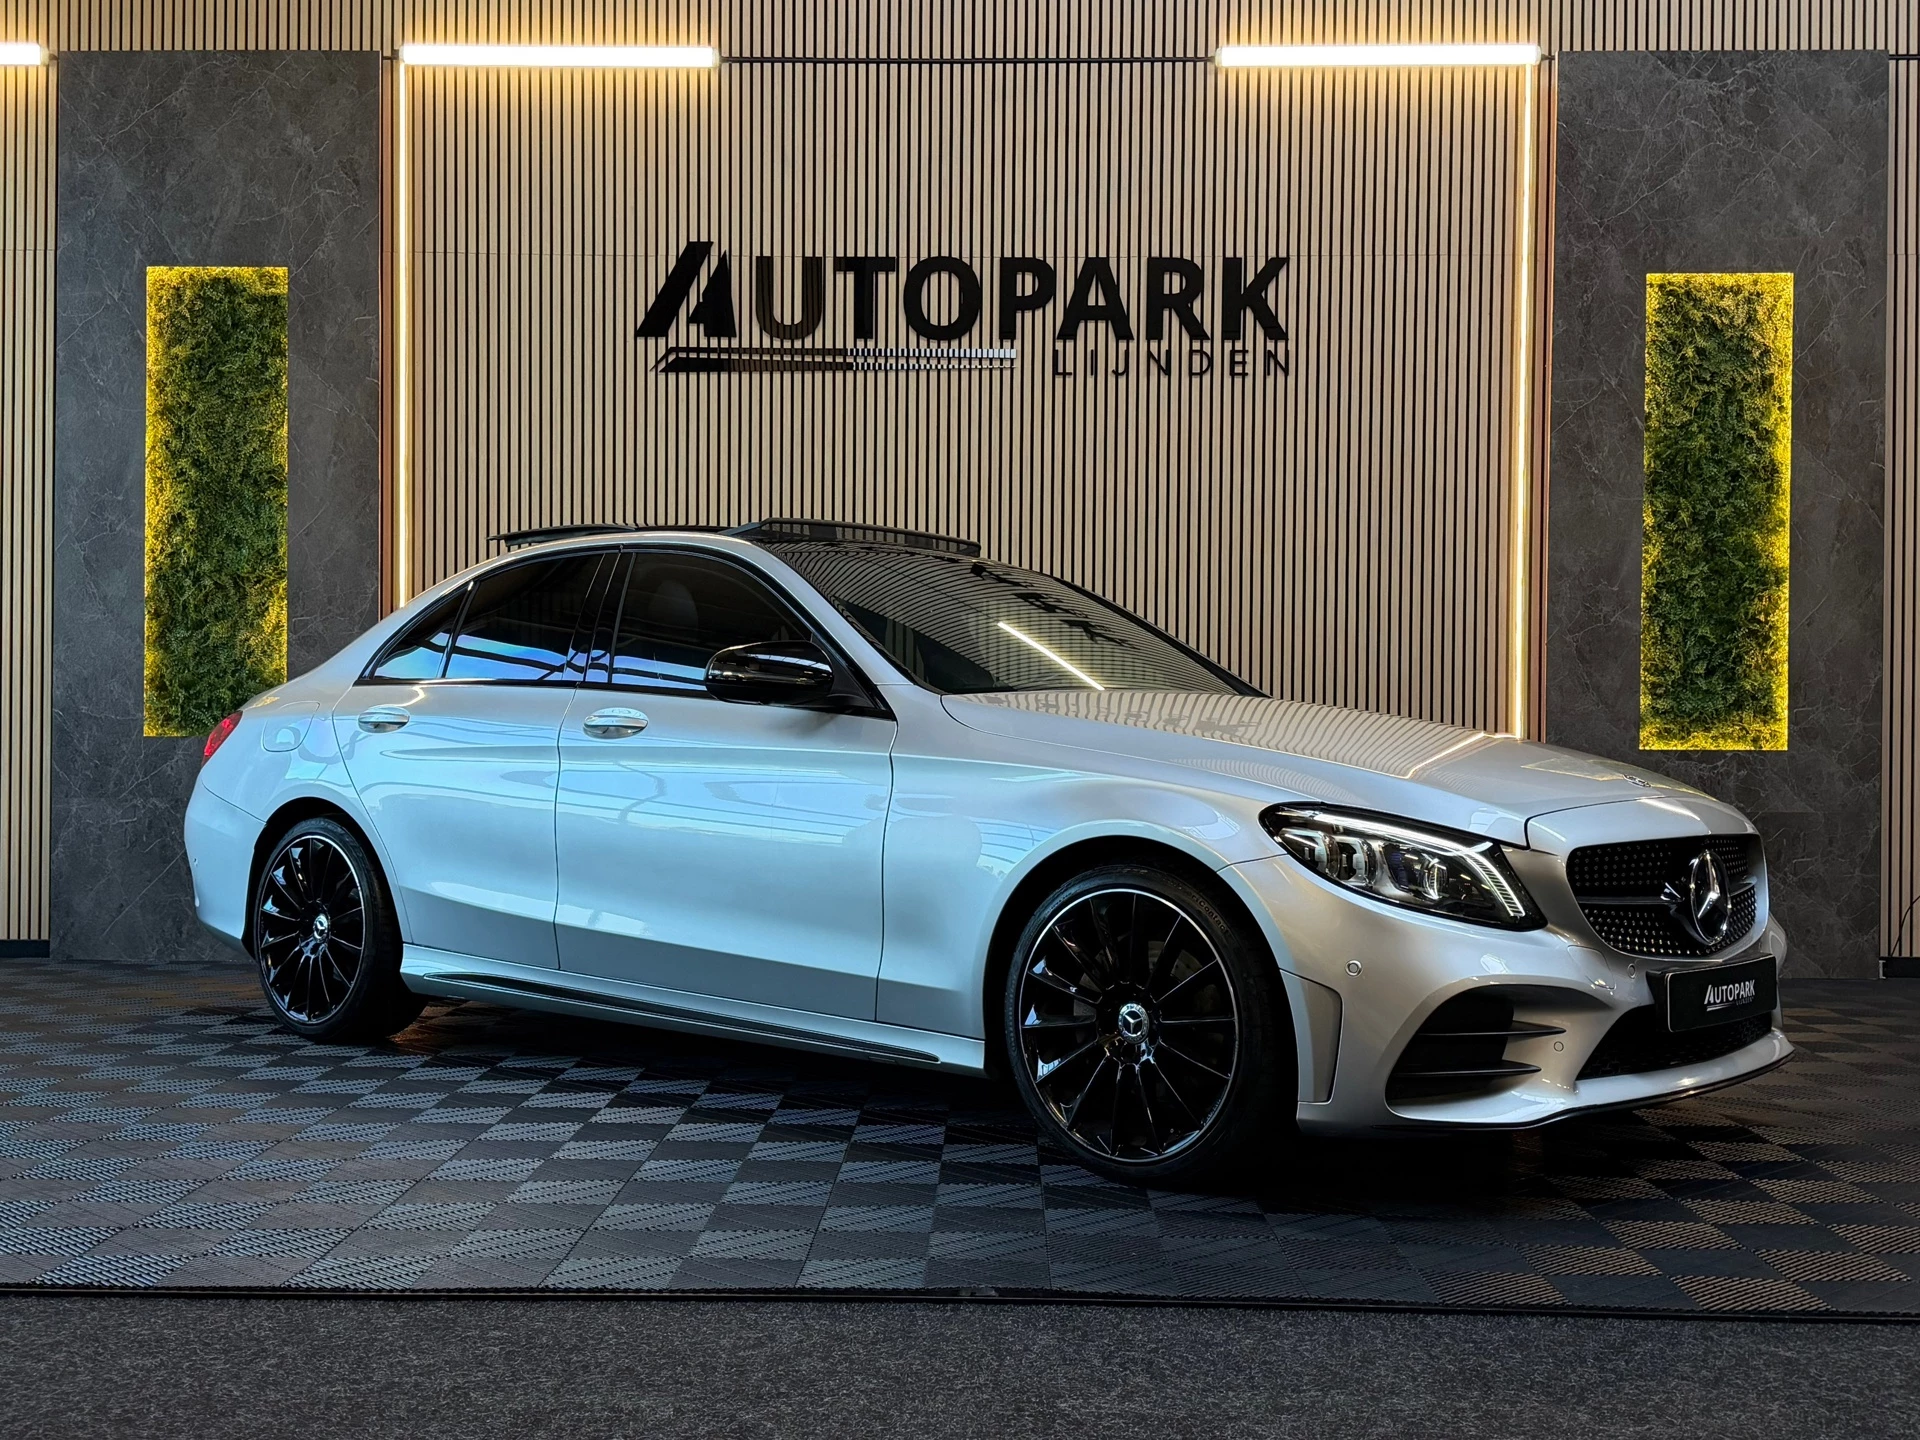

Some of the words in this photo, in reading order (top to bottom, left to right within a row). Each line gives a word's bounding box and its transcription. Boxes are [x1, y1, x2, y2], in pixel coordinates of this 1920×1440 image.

[635, 241, 1289, 340] AUTOPARK
[1054, 349, 1289, 376] LIJNDEN
[1704, 979, 1755, 1004] AUTOPARK
